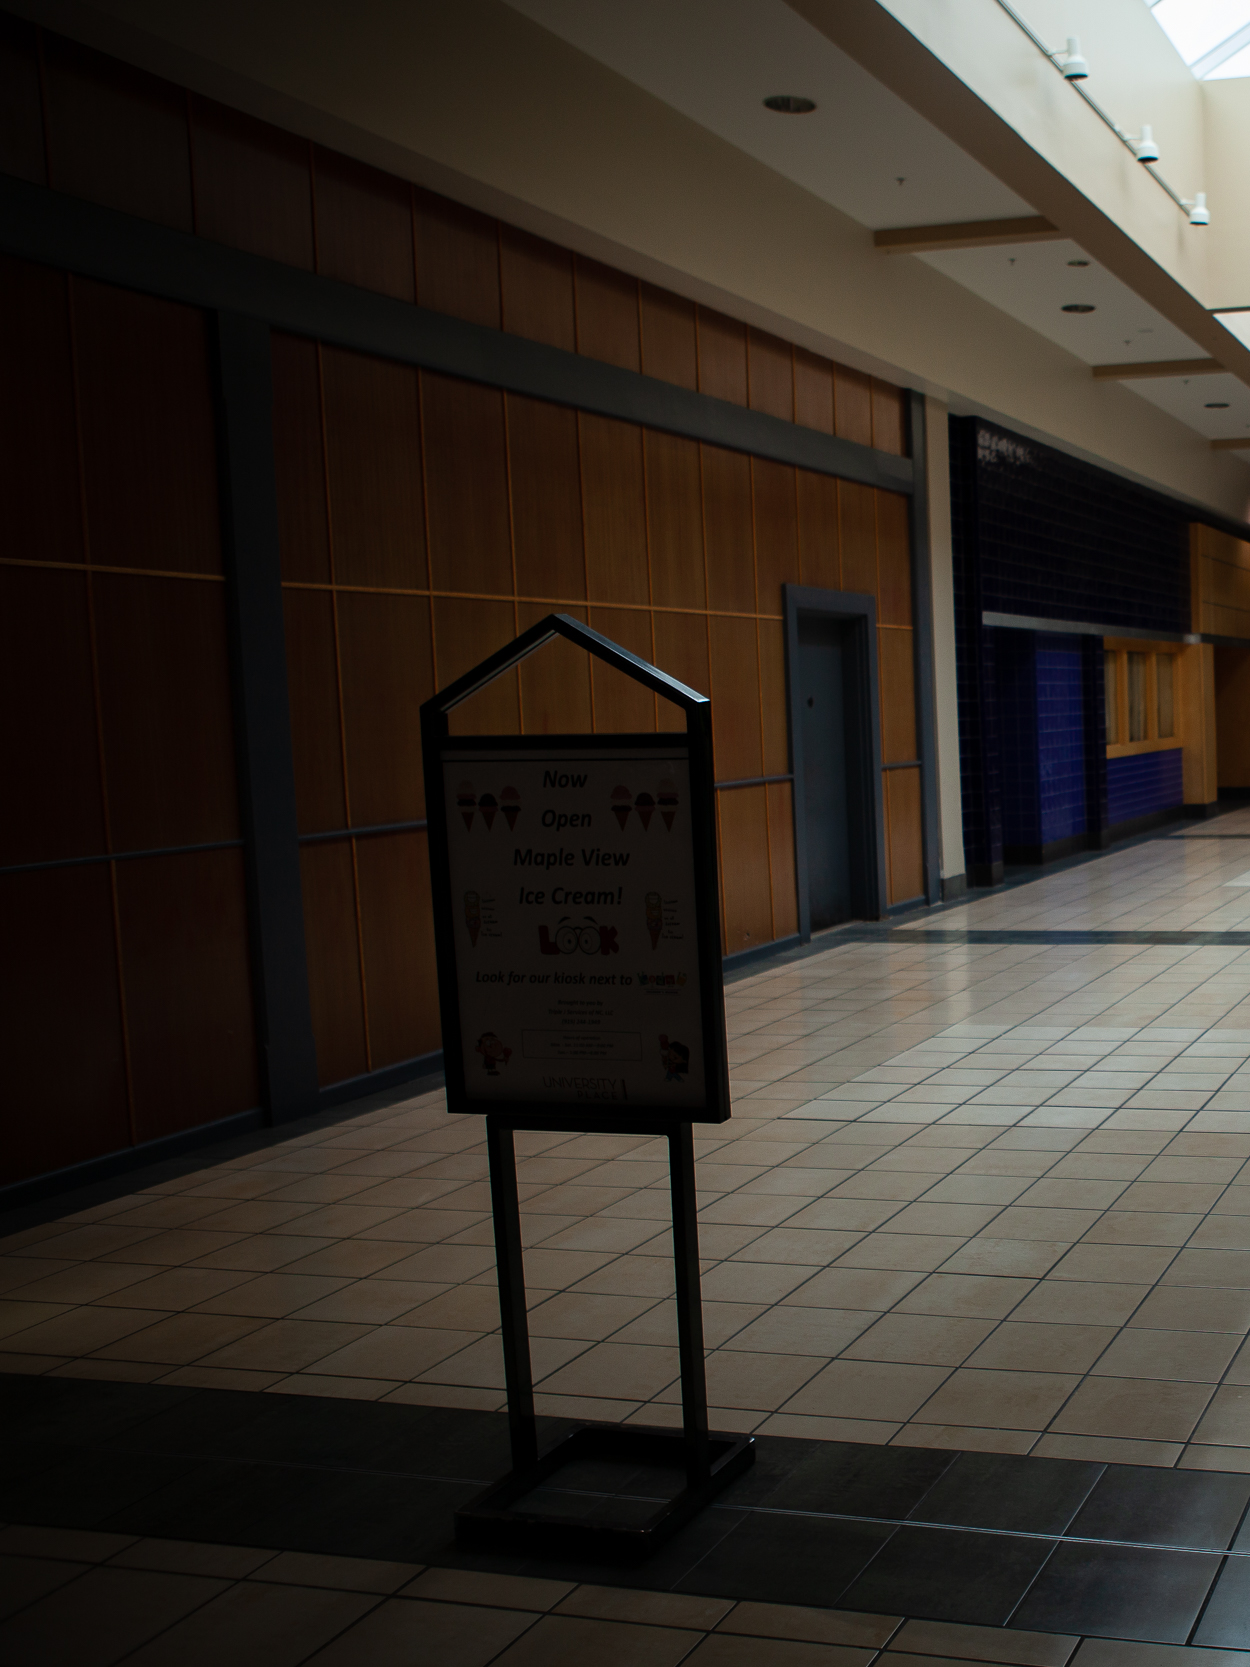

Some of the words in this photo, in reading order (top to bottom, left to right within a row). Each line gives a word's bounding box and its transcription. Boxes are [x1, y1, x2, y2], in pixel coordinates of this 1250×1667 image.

[542, 770, 588, 788] Now
[540, 809, 592, 832] Open
[513, 847, 575, 870] Maple
[581, 848, 630, 867] View
[518, 886, 546, 905] Ice
[551, 886, 623, 906] Cream!
[537, 924, 620, 956] LOOK
[475, 971, 505, 984] Look
[506, 971, 527, 986] for
[529, 974, 551, 984] our
[553, 972, 586, 985] kiosk
[588, 973, 617, 985] next
[619, 973, 633, 986] to
[542, 1076, 617, 1091] UNIVERSITY
[576, 1090, 619, 1101] PLACE
